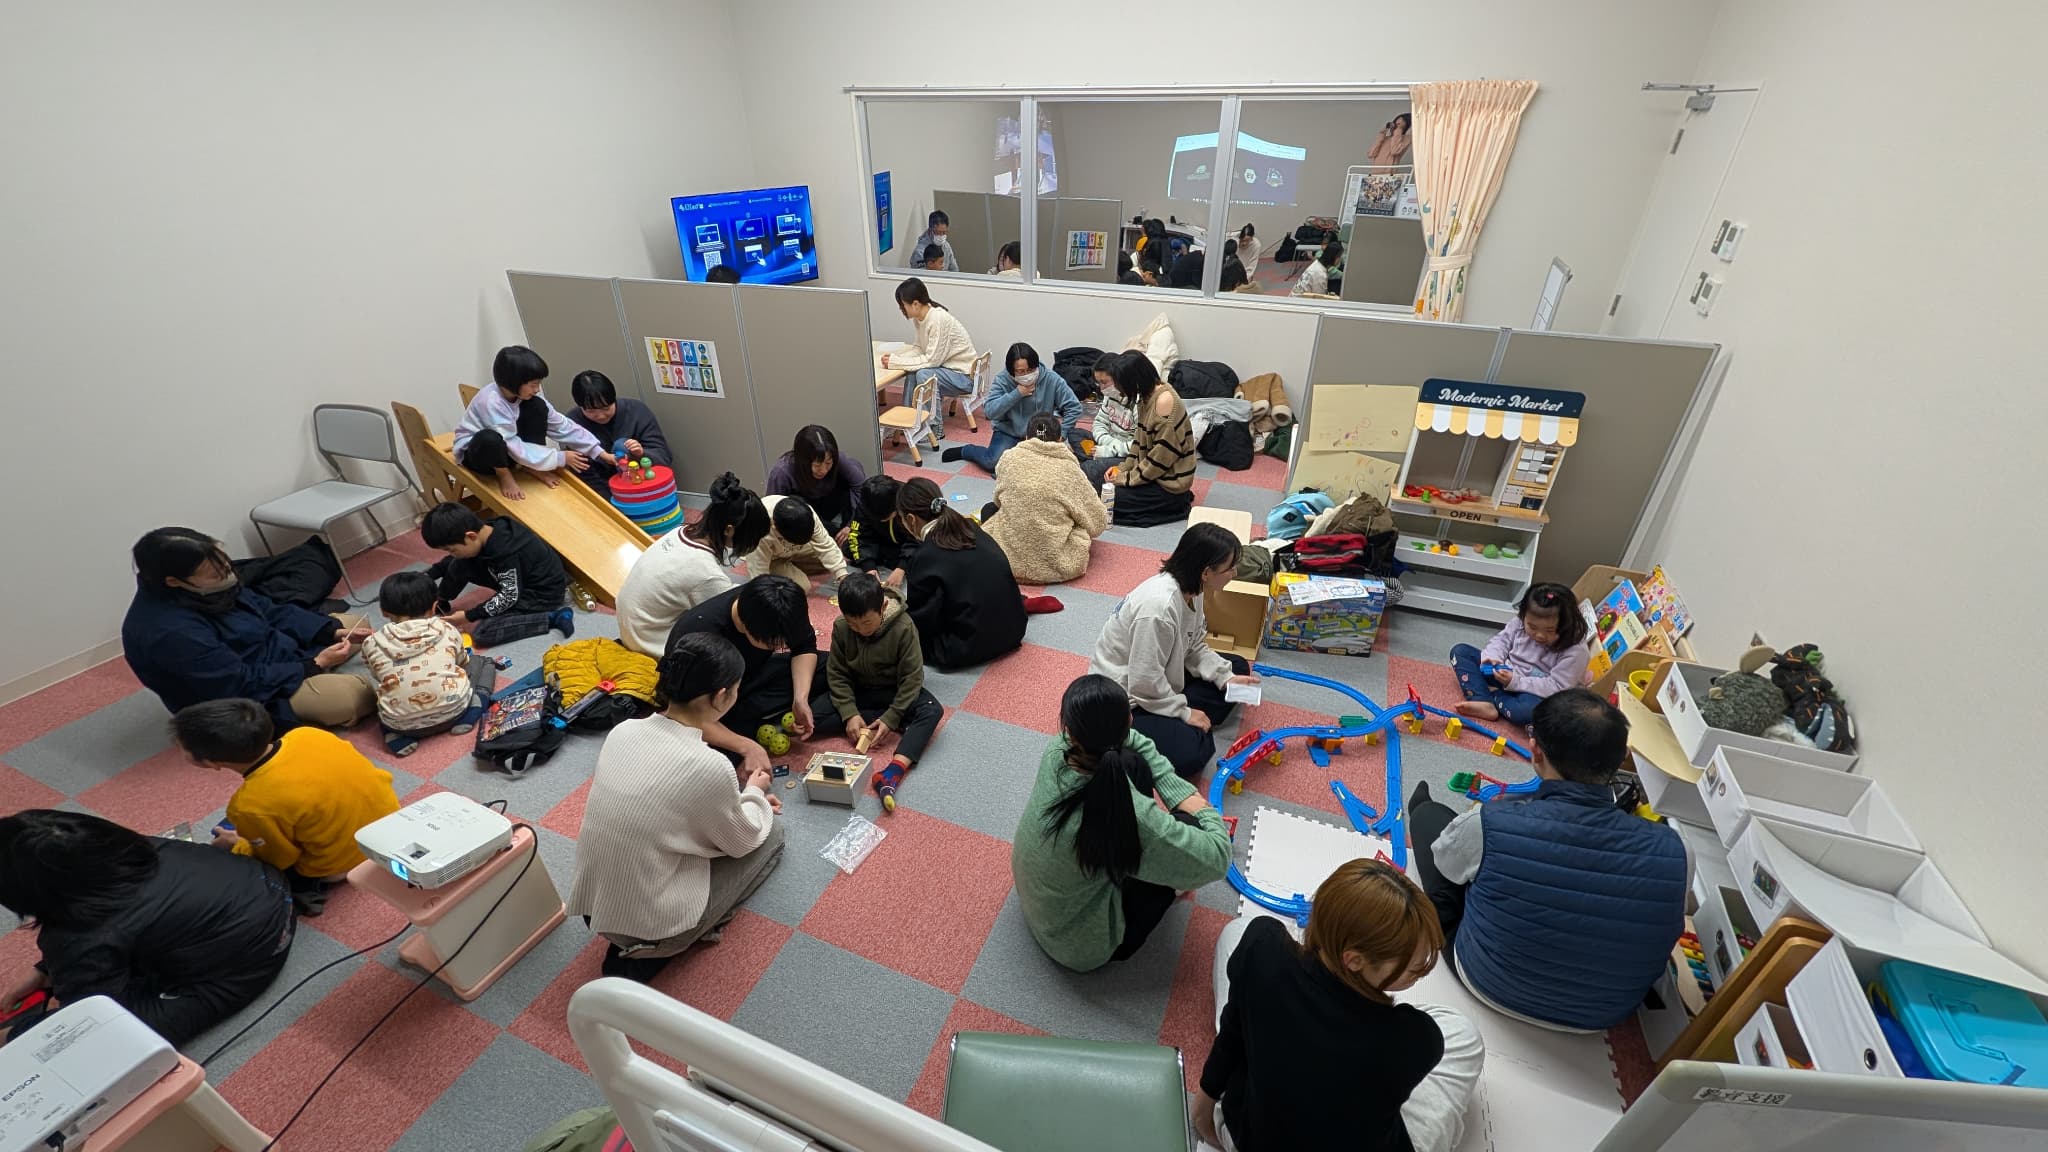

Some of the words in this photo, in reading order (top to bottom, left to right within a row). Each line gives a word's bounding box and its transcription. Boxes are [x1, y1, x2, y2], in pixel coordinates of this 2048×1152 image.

[1438, 387, 1506, 407] Modernic
[1507, 394, 1565, 412] Market
[1450, 510, 1482, 521] OPEN
[1, 1074, 40, 1102] EPSON
